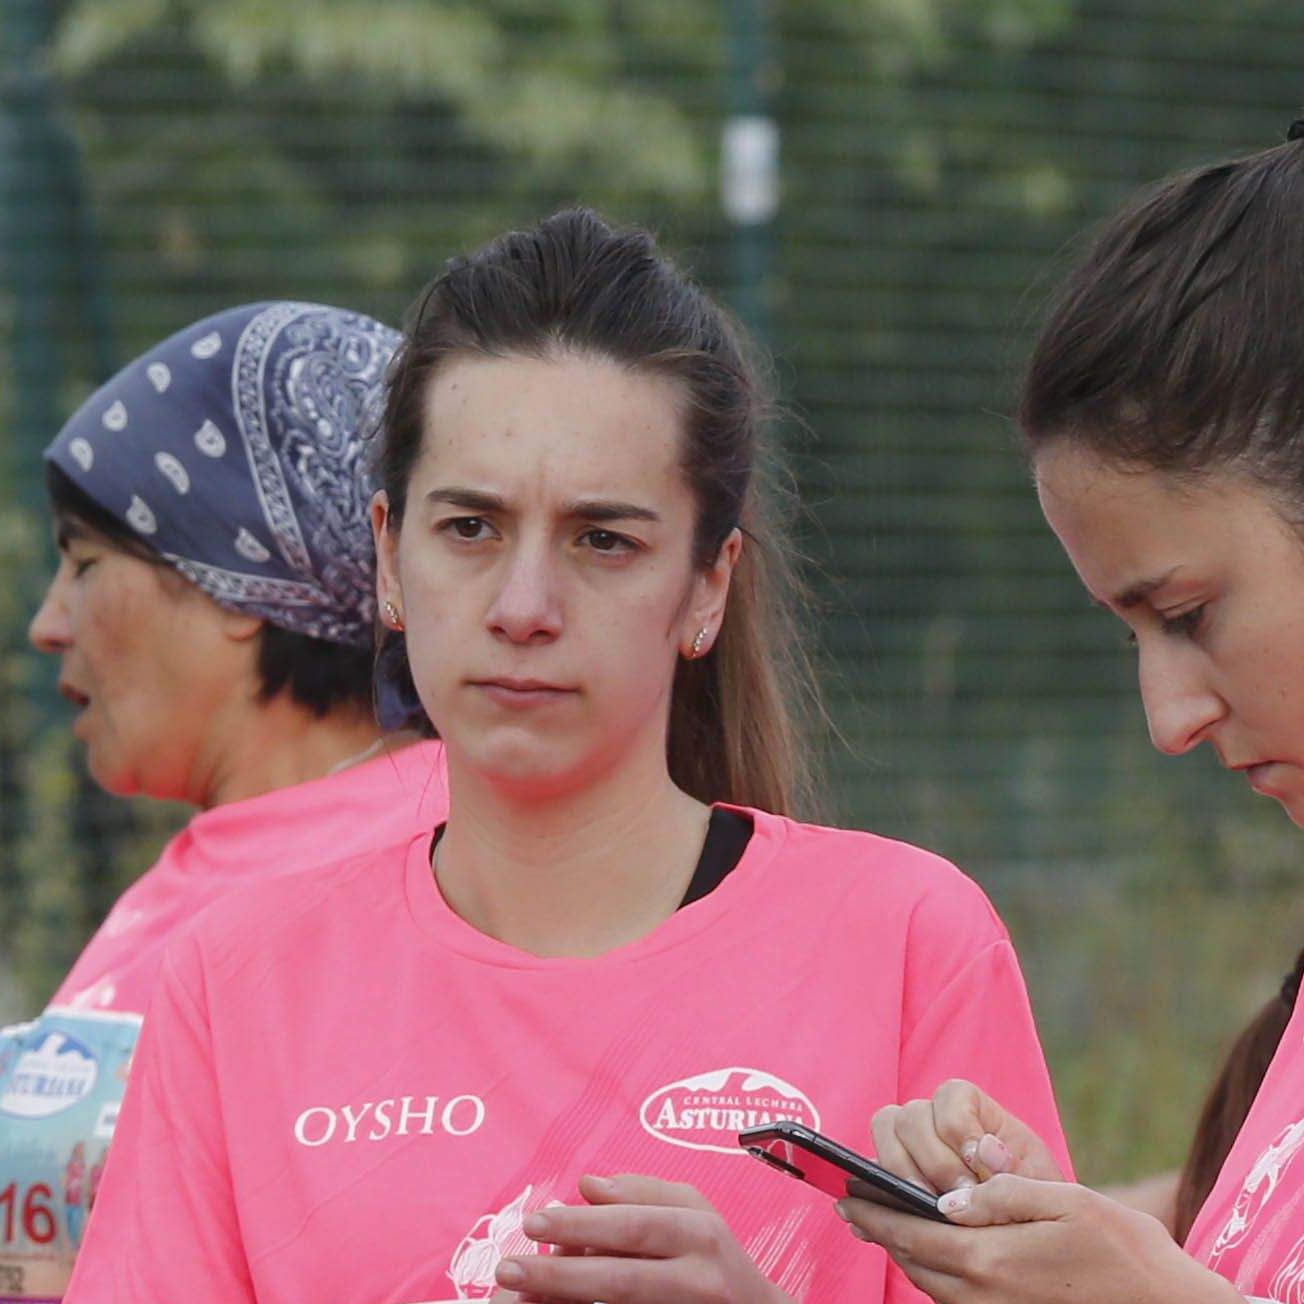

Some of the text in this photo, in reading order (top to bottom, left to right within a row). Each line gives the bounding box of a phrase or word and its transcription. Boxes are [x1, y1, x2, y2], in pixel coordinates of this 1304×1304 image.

[683, 1095, 804, 1112] CENTRAL LECHERA
[295, 1095, 486, 1147] OYSHO
